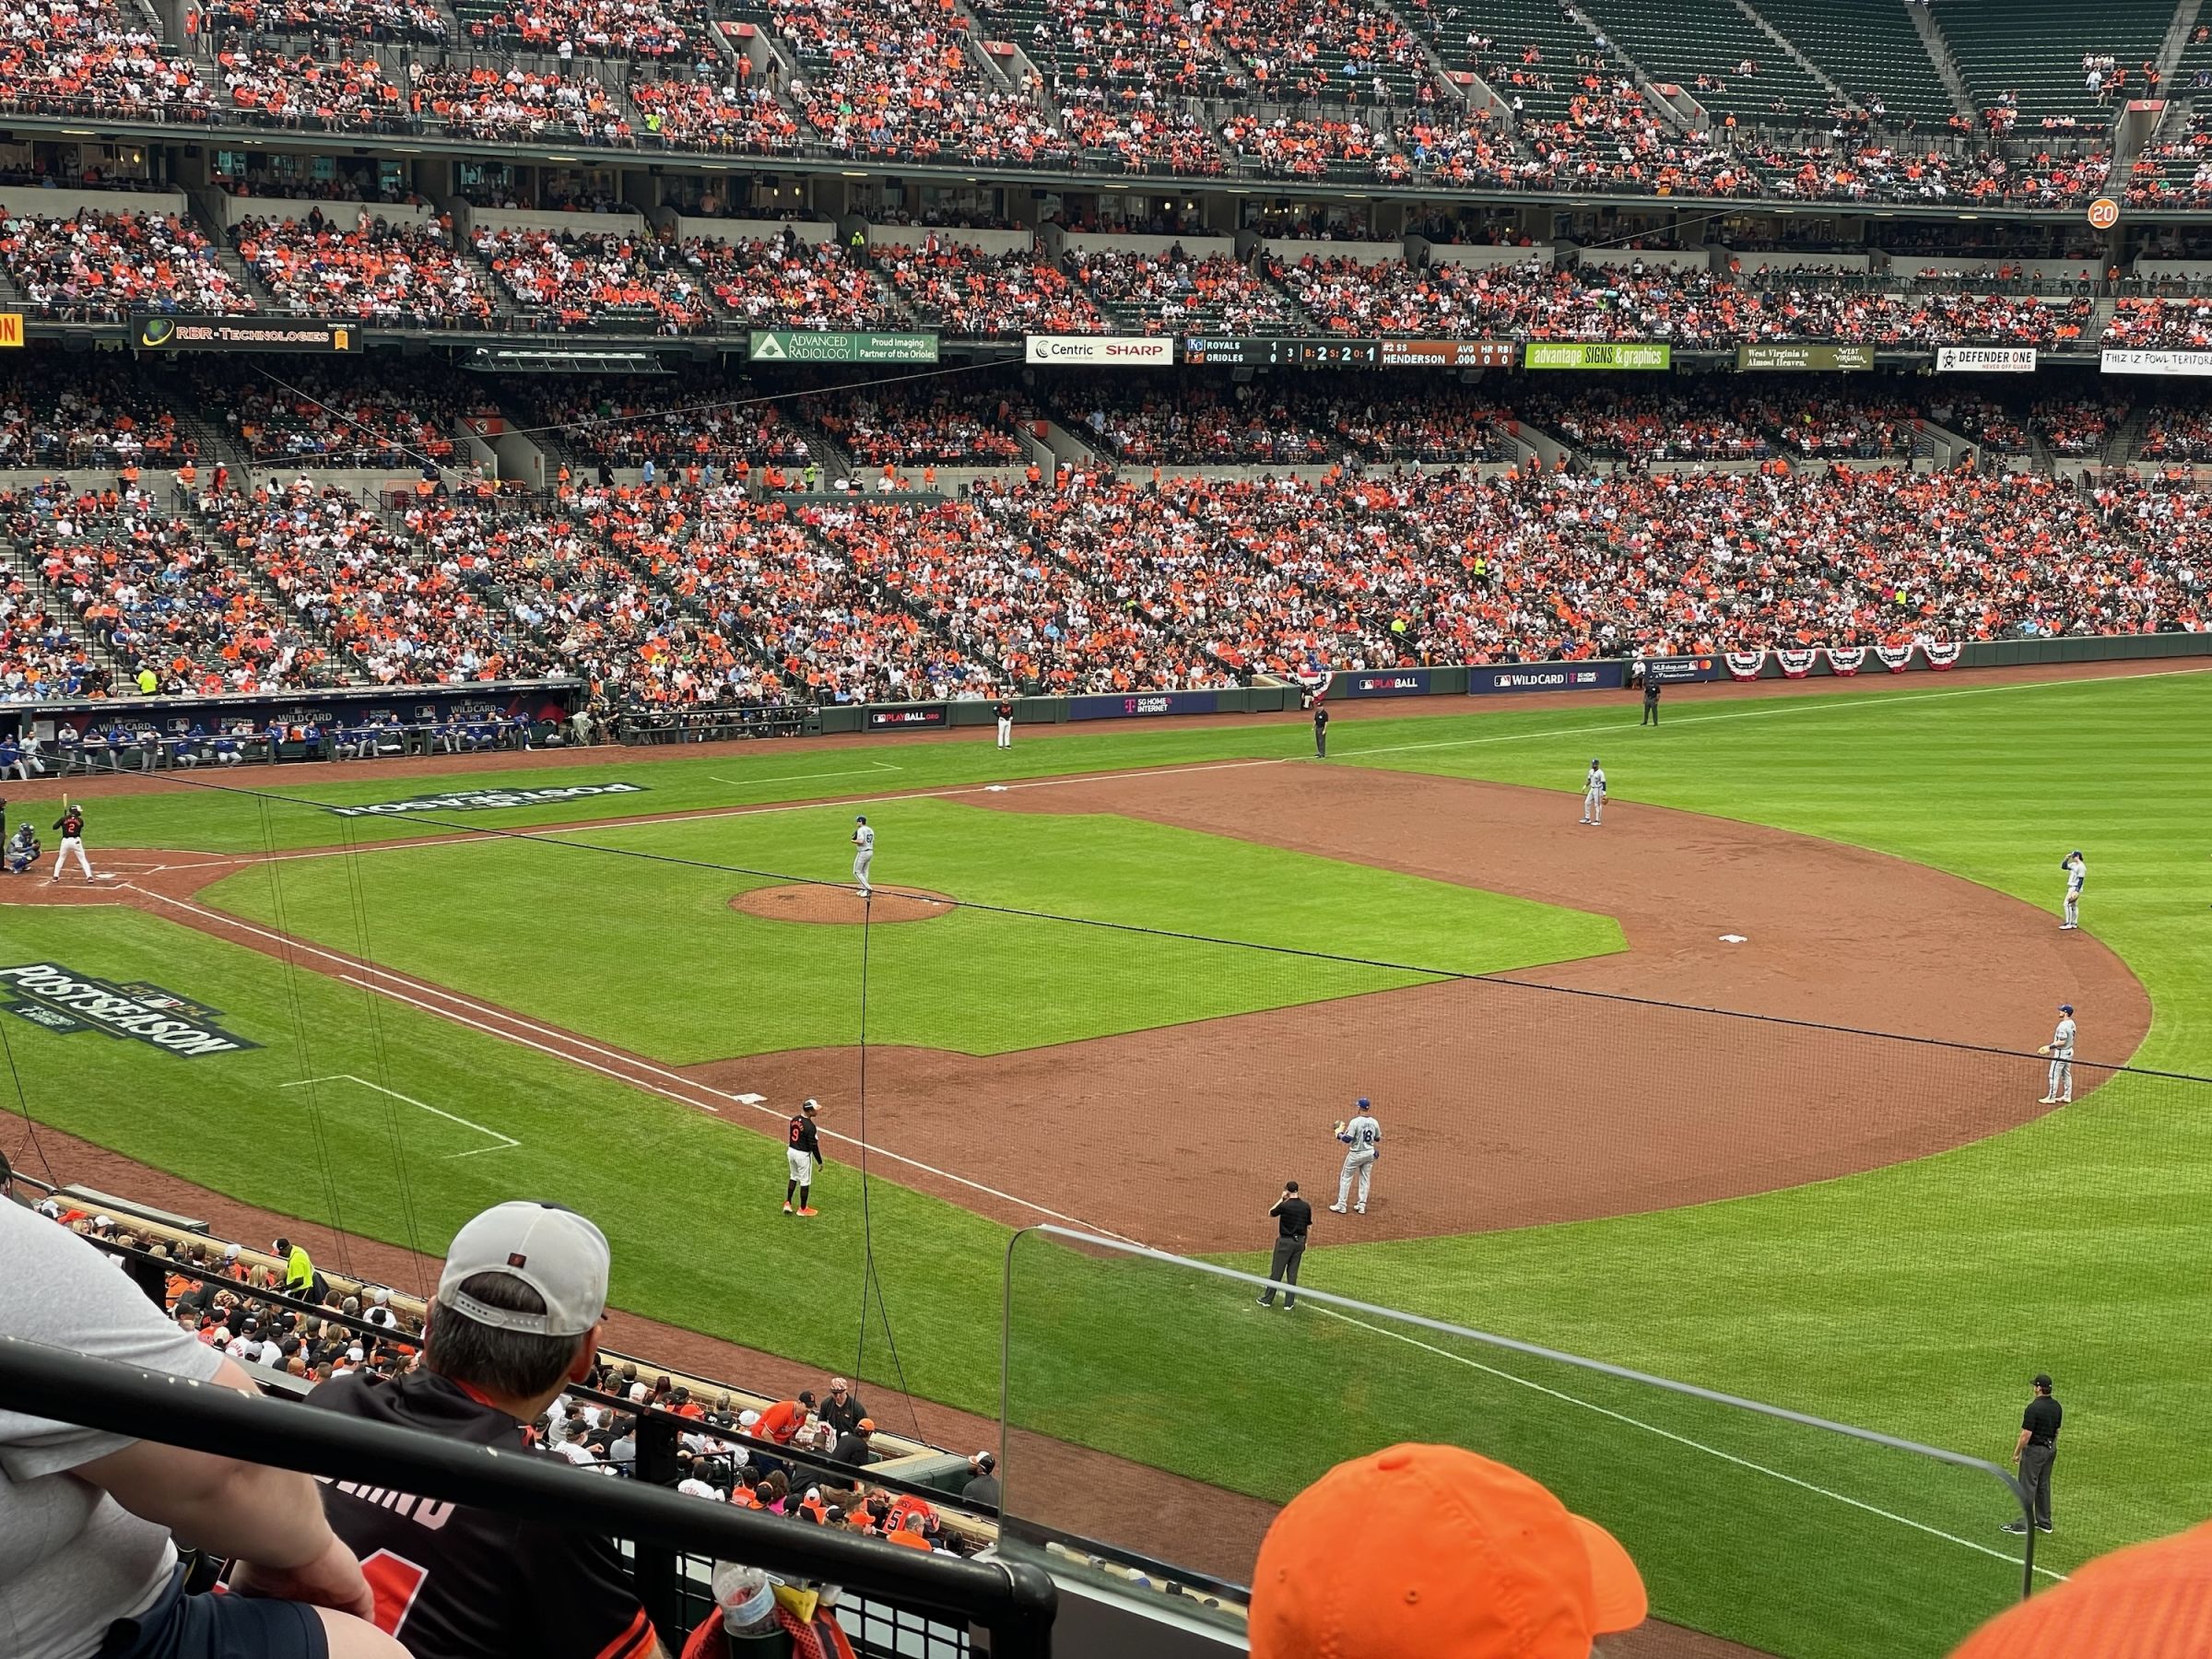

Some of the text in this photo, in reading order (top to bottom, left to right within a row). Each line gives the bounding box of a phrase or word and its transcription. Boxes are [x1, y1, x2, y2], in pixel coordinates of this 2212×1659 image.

[2093, 206, 2113, 222] 20
[0, 318, 16, 341] N
[789, 334, 847, 347] ADVANCED
[871, 338, 924, 348] Proud Imaging
[1206, 341, 1277, 351] ROYALS 1
[789, 346, 851, 359] RADIOLOGY
[860, 350, 935, 359] Partner of the Orioles
[1052, 344, 1093, 355] Centric
[1106, 346, 1163, 356] SHARP
[1288, 347, 1294, 358] 3
[1305, 348, 1315, 358] B:
[1317, 347, 1327, 361] 2
[1329, 349, 1338, 359] S:
[1341, 347, 1351, 361] 2
[1366, 347, 1375, 361] 1
[1383, 344, 1512, 354] #2 SS AVG HR RBI
[1748, 348, 1766, 358] West
[1769, 348, 1800, 359] Virginia
[1206, 353, 1277, 362] ORIOLES 0
[1383, 354, 1509, 364] HENDERSON .000 0 0
[1534, 347, 1662, 367] advantage SIGNS & graphics
[1832, 354, 1867, 364] VIRGINIA
[1959, 351, 2032, 363] DEFENDER ONE
[2105, 353, 2127, 363] THIZ
[2131, 354, 2142, 363] IZ
[2145, 353, 2170, 363] FOWL
[1747, 359, 1806, 367] Almost Heaven.
[1512, 674, 1564, 686] WILD CARD
[1147, 697, 1167, 705] HOME
[1137, 703, 1169, 712] INTERNET
[68, 823, 76, 833] 2
[0, 965, 241, 1055] POSTSEASON
[1362, 1129, 1372, 1142] 18
[887, 1509, 903, 1531] 5
